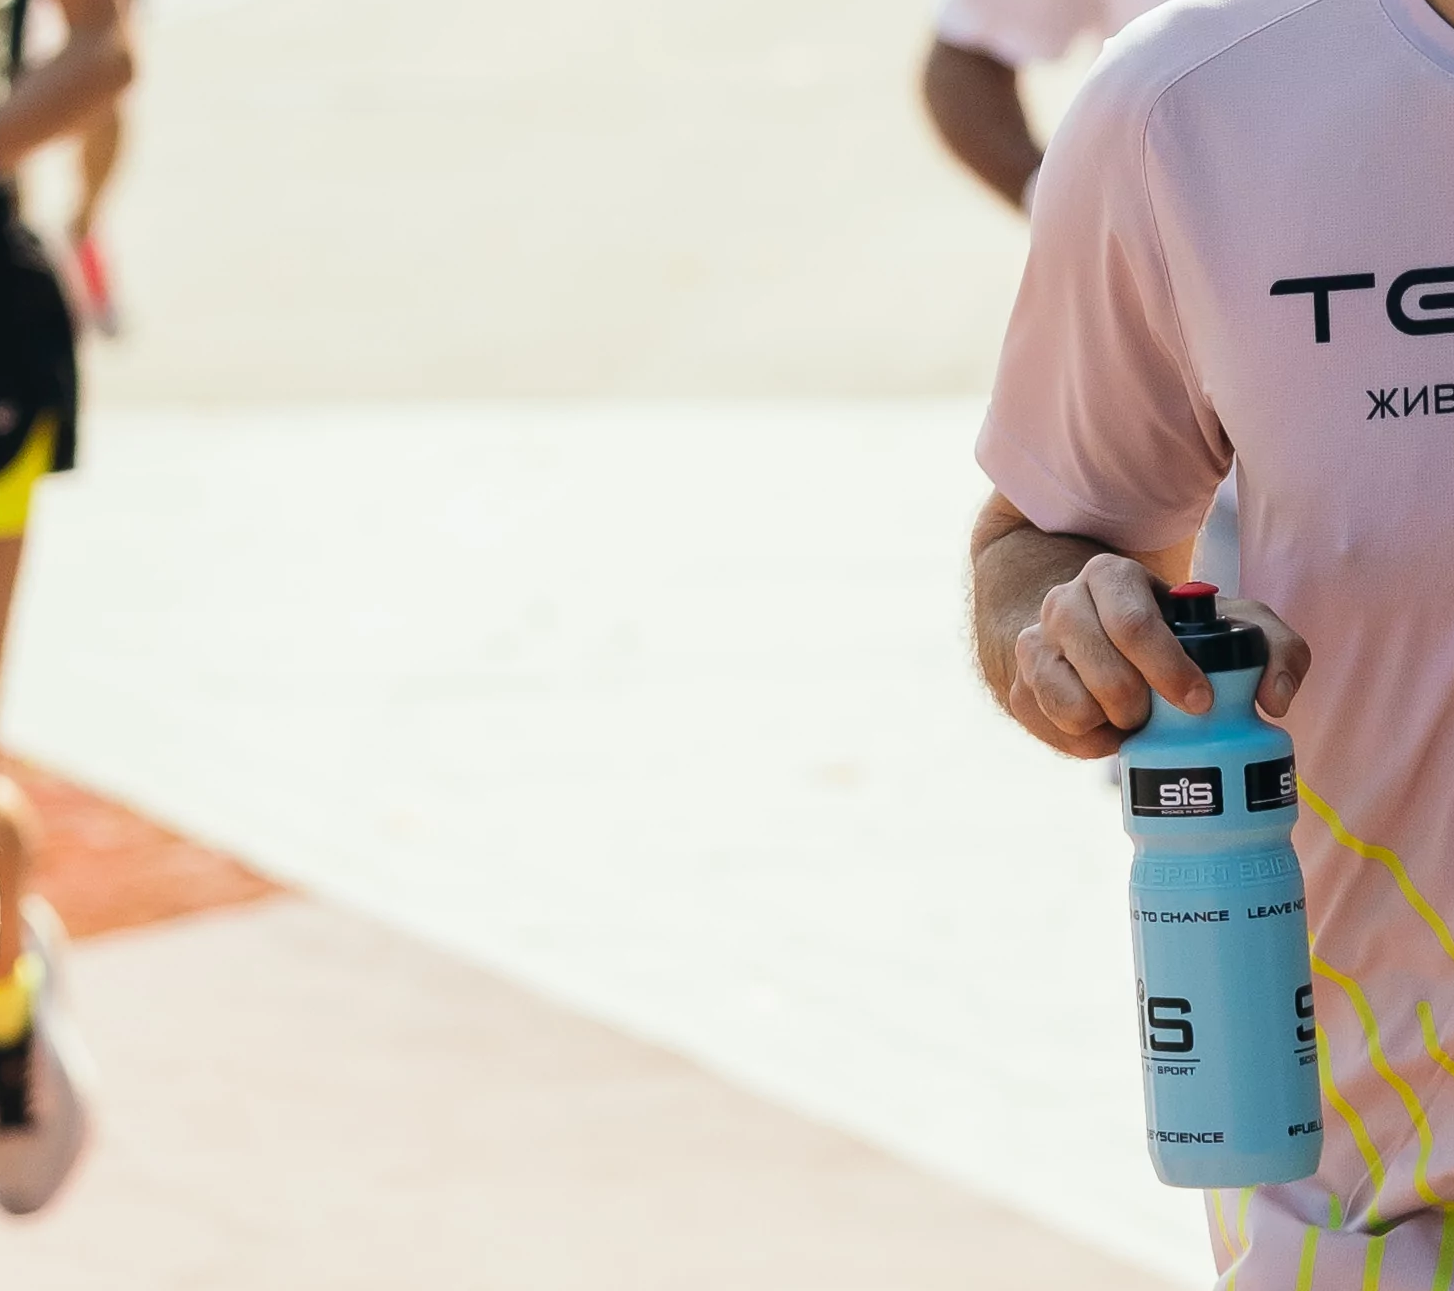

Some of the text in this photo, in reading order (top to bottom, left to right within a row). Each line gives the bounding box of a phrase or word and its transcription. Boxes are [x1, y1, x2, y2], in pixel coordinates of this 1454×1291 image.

[1141, 910, 1157, 923] TO
[1160, 910, 1230, 924] CHANCE
[1247, 902, 1292, 919] LEAVE
[1157, 1065, 1197, 1076] SPORT
